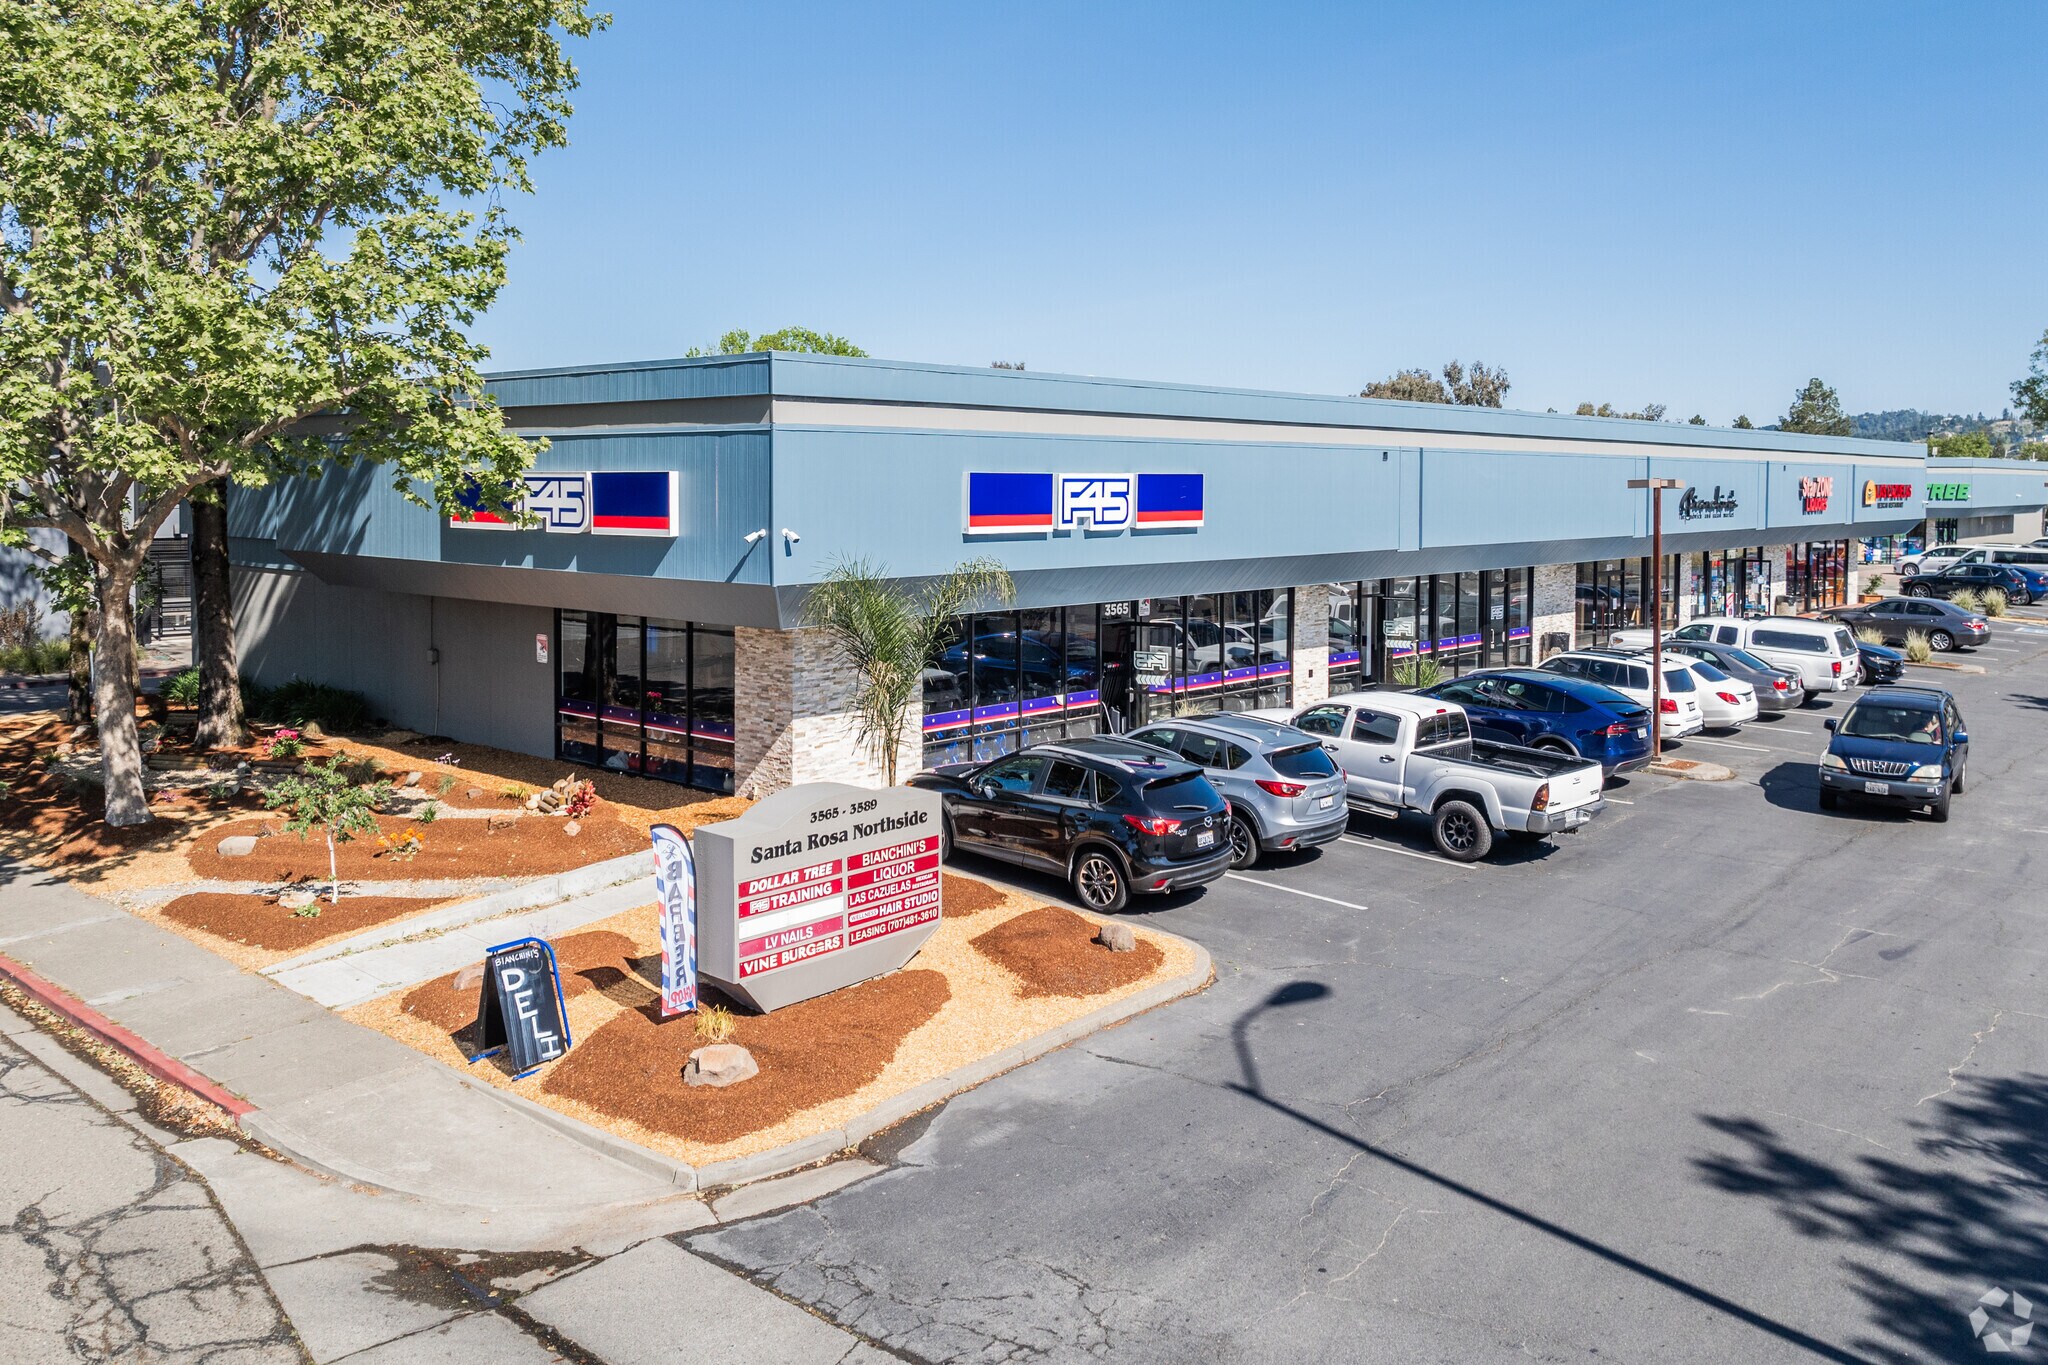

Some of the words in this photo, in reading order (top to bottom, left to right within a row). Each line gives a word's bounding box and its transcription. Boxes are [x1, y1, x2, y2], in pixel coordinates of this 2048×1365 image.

[1061, 478, 1131, 525] F45
[1104, 602, 1129, 616] 3565
[810, 807, 839, 824] 3565
[849, 799, 878, 815] 3589
[751, 839, 802, 864] Santa
[807, 830, 849, 851] Rosa
[853, 810, 928, 840] Northside
[862, 840, 926, 867] BIANCHINI'S
[749, 871, 799, 895] DOLLAR
[803, 862, 833, 881] TREE
[873, 861, 915, 882] LIQUOR
[749, 898, 770, 914] F45
[771, 882, 832, 909] TRAINING
[849, 891, 866, 906] LAS
[868, 880, 911, 901] CAZUELAS
[851, 909, 877, 921] WELLNESS
[879, 900, 903, 917] HAIR
[904, 890, 938, 909] STUDIO
[765, 935, 778, 950] LV
[781, 926, 814, 946] NAILS
[851, 924, 886, 943] LEASING
[494, 948, 540, 967] BIANCHINI'S
[744, 954, 778, 975] VINE
[501, 968, 562, 1059] DELI
